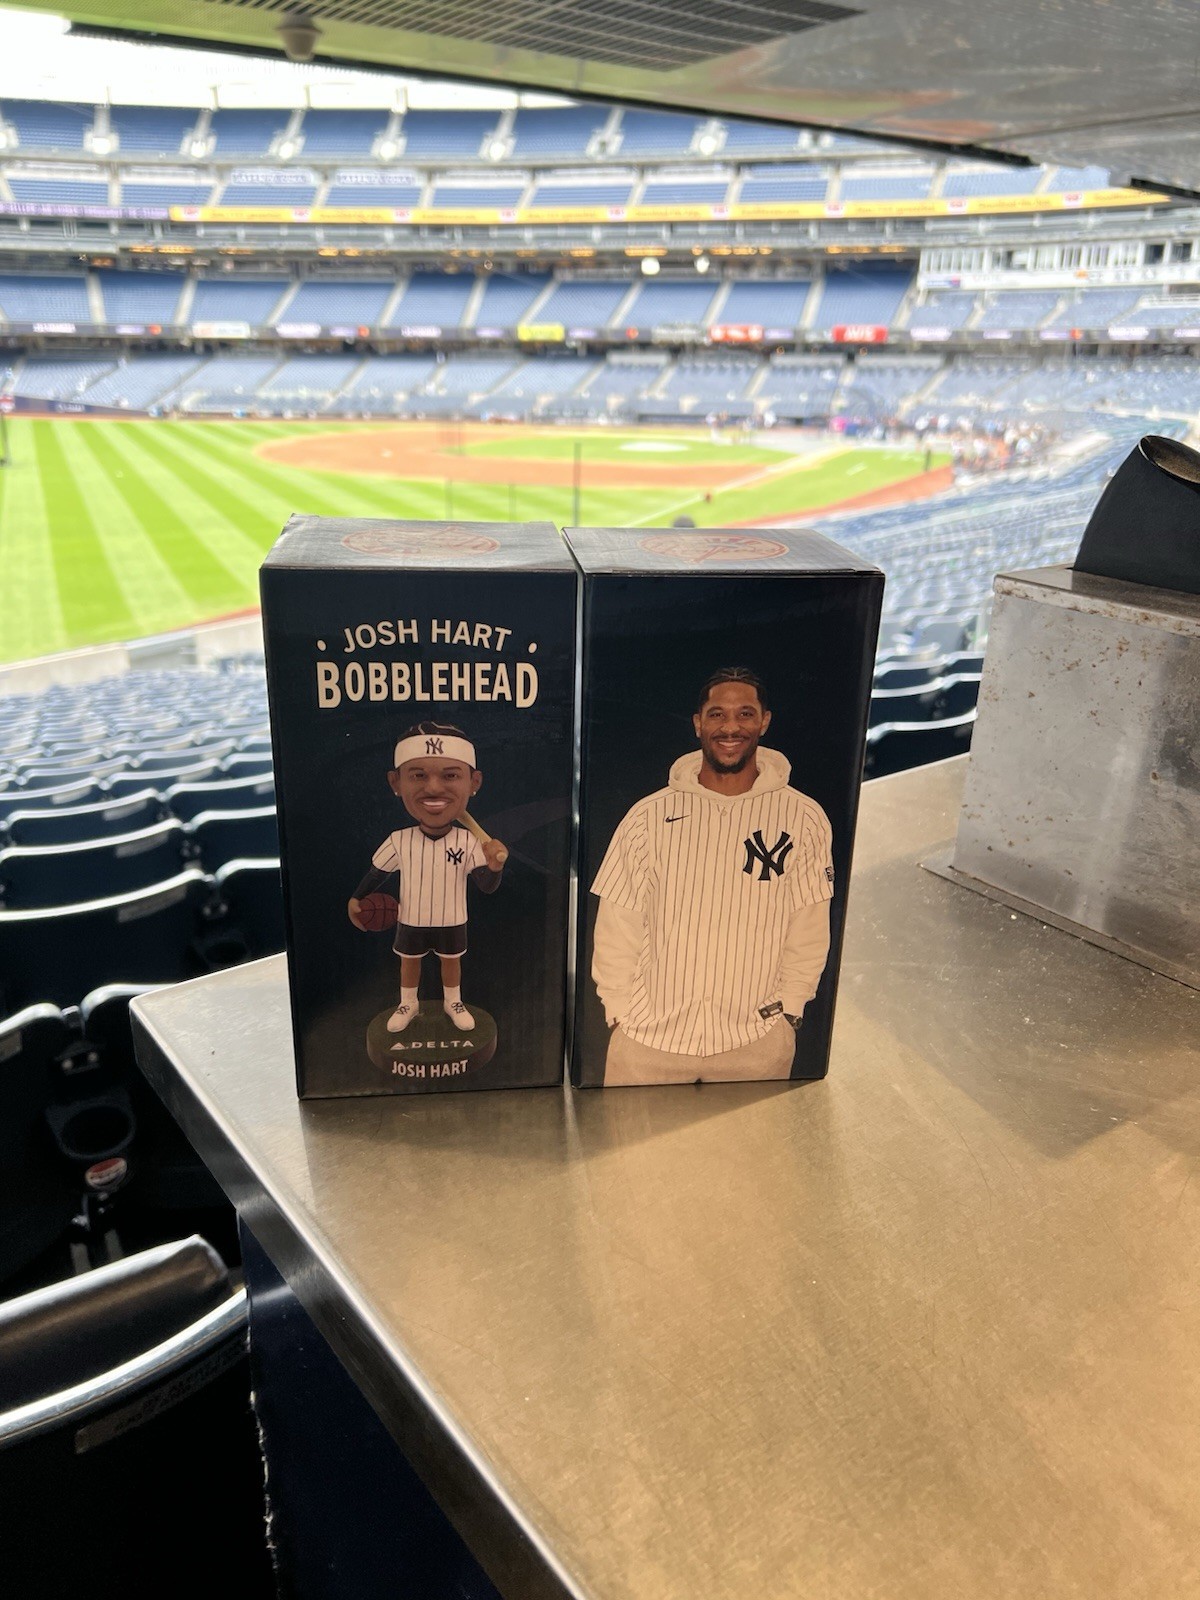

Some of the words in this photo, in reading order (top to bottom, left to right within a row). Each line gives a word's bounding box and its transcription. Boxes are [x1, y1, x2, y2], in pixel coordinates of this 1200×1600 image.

[343, 618, 419, 653] JOSH
[431, 618, 513, 652] HART
[316, 661, 539, 709] BOBBLEHEAD
[742, 829, 794, 881] NY
[411, 1040, 474, 1048] DELTA
[392, 1061, 426, 1078] JOSH
[430, 1059, 468, 1078] HART
